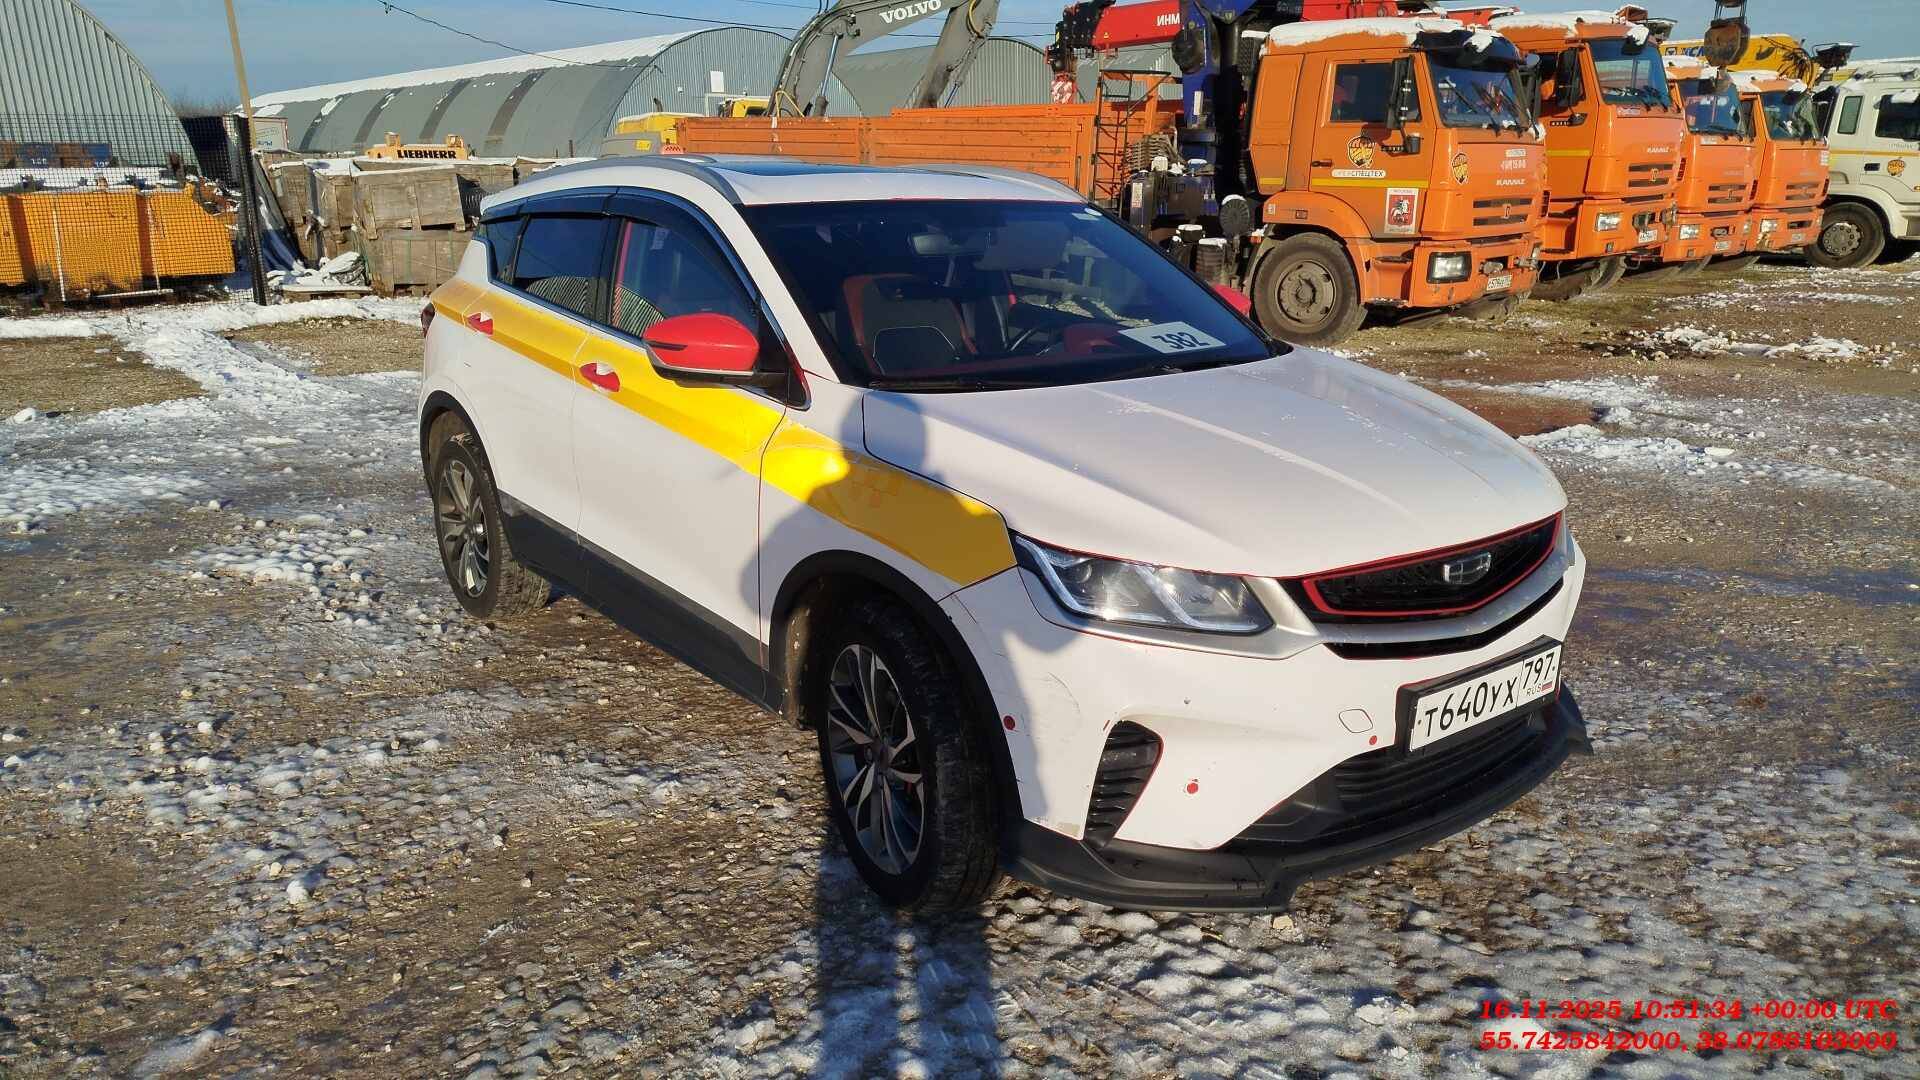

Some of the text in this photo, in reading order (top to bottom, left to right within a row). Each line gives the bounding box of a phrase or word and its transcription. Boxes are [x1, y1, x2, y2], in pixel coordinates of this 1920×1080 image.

[879, 0, 941, 24] VOLVO
[397, 150, 457, 159] LIEBHERR
[1152, 332, 1211, 350] 382
[1424, 652, 1555, 738] Т640УХ 797
[1526, 684, 1542, 697] RUS
